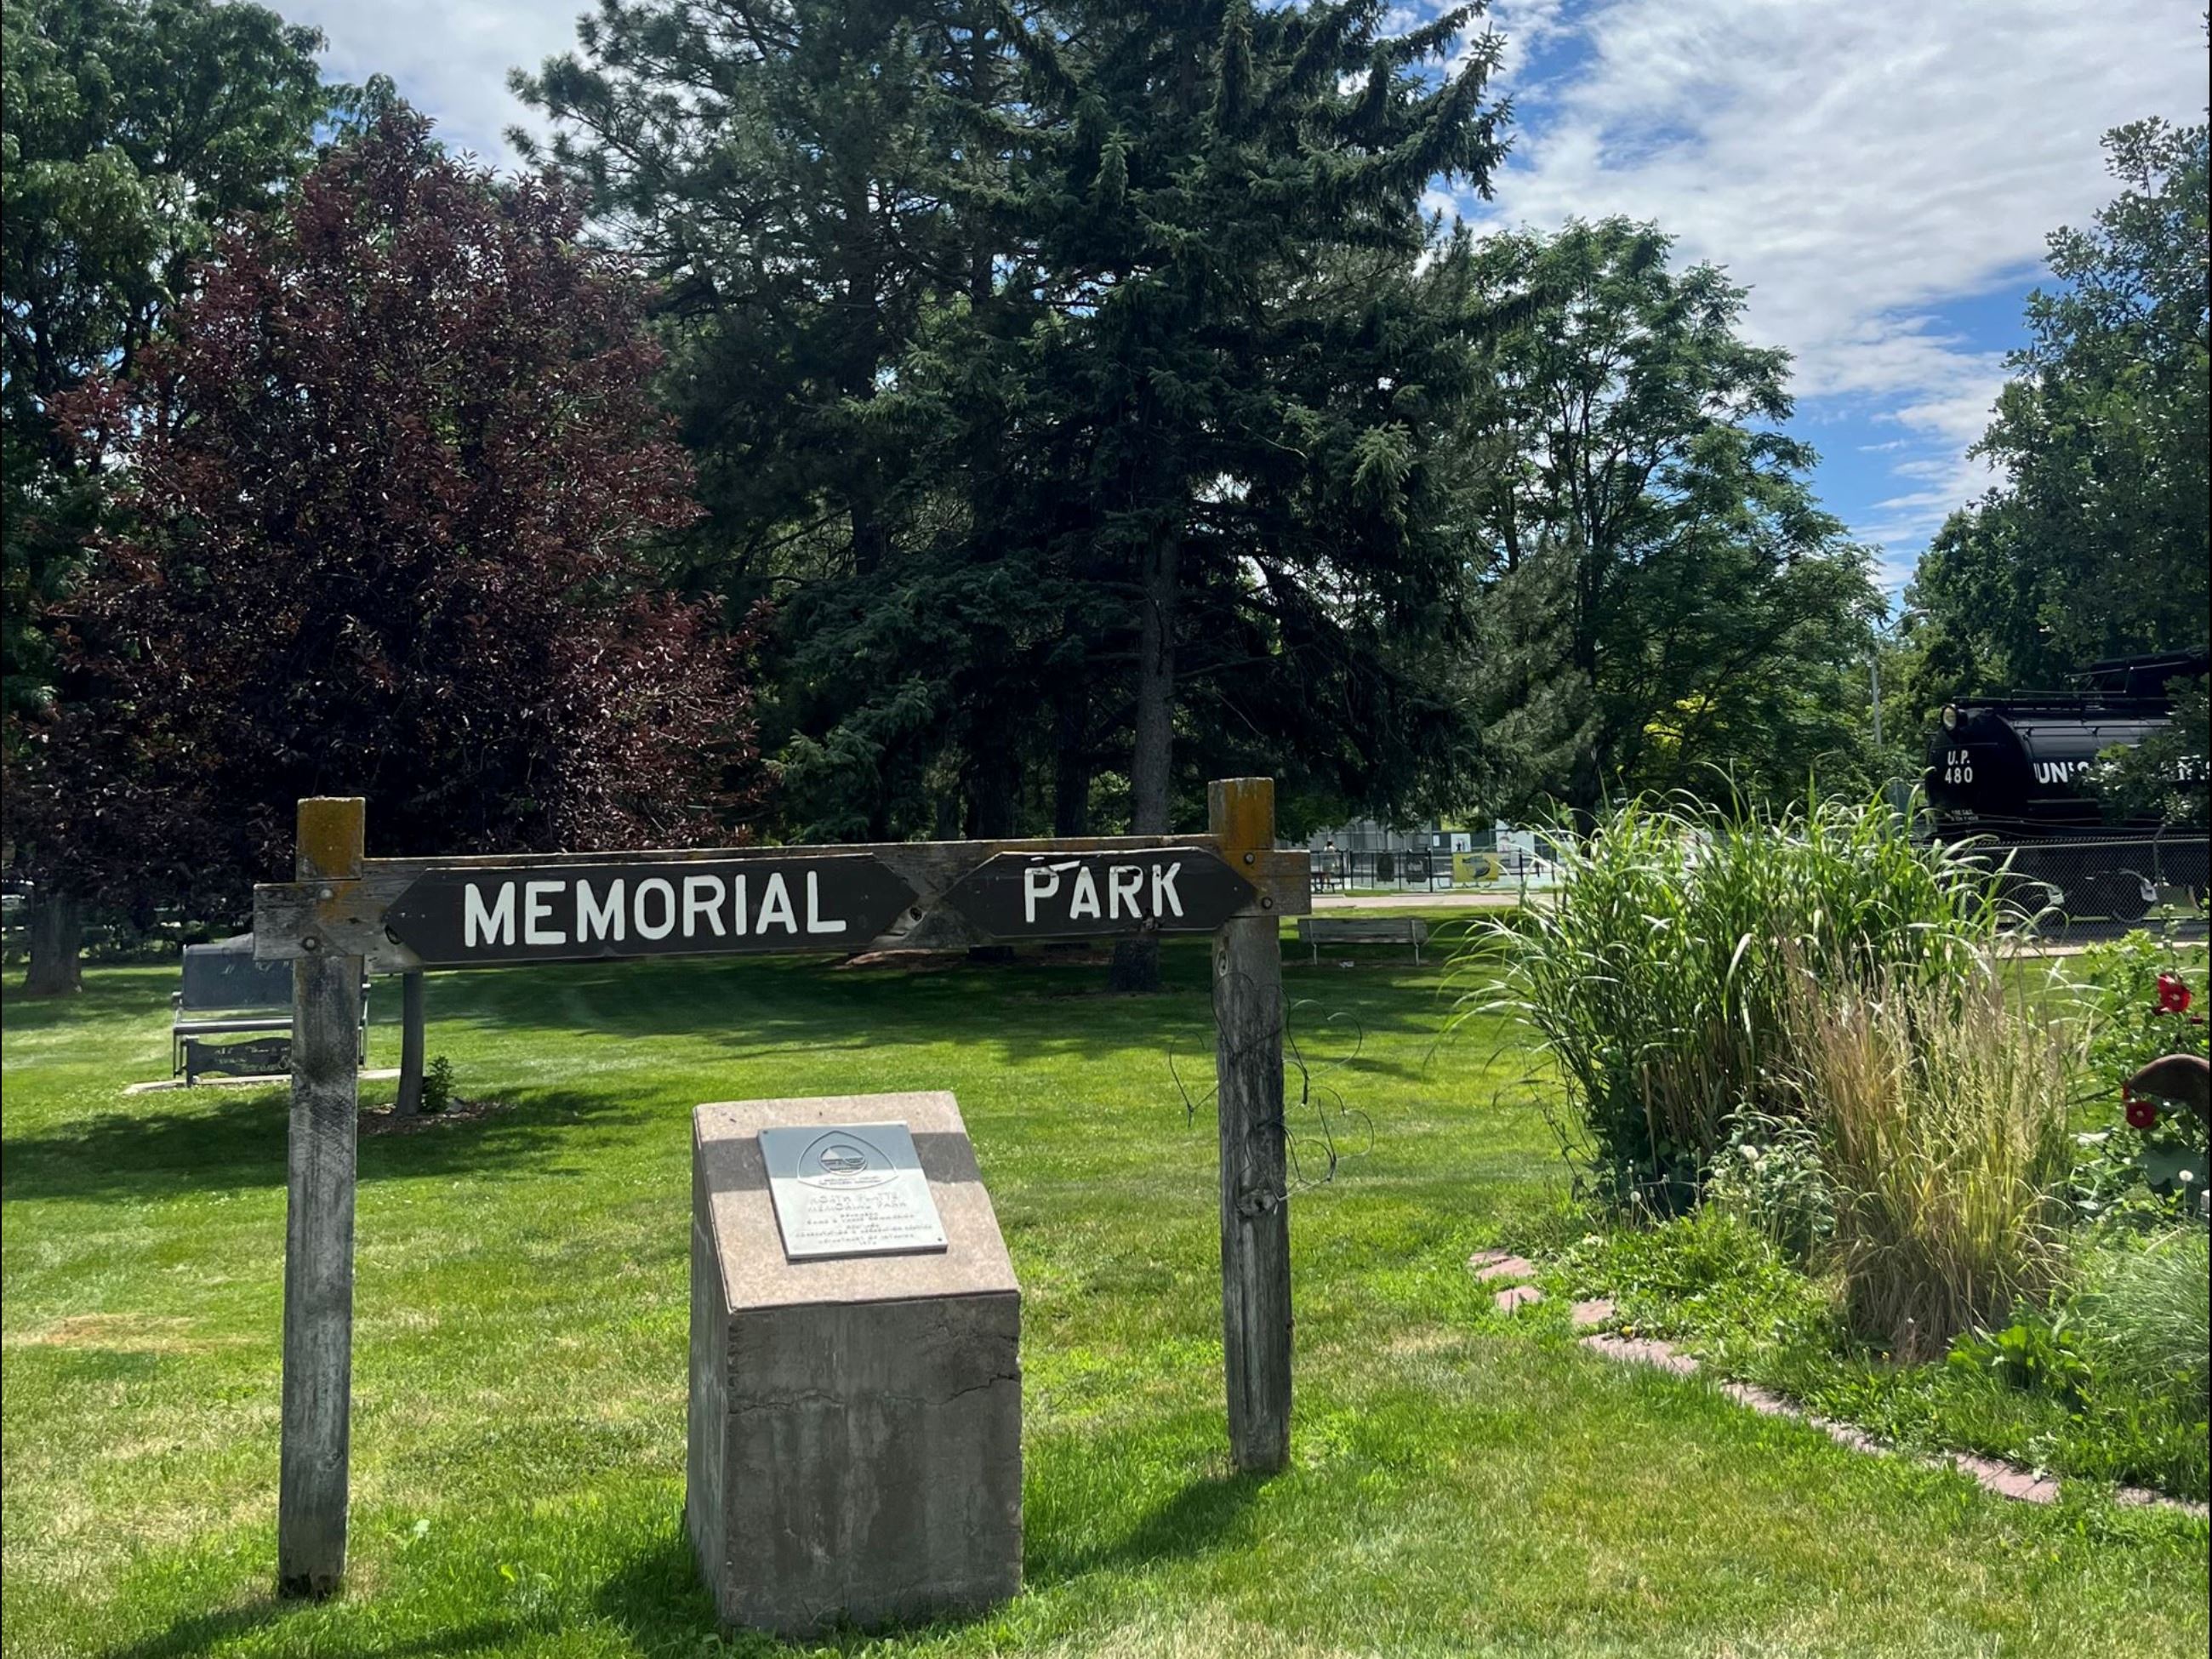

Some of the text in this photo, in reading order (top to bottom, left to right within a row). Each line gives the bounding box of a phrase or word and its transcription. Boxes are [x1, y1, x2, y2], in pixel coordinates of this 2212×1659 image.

[1947, 750, 1970, 766] U.P.
[1945, 767, 1973, 784] 480
[464, 859, 1184, 948] MEMORIAL PARK
